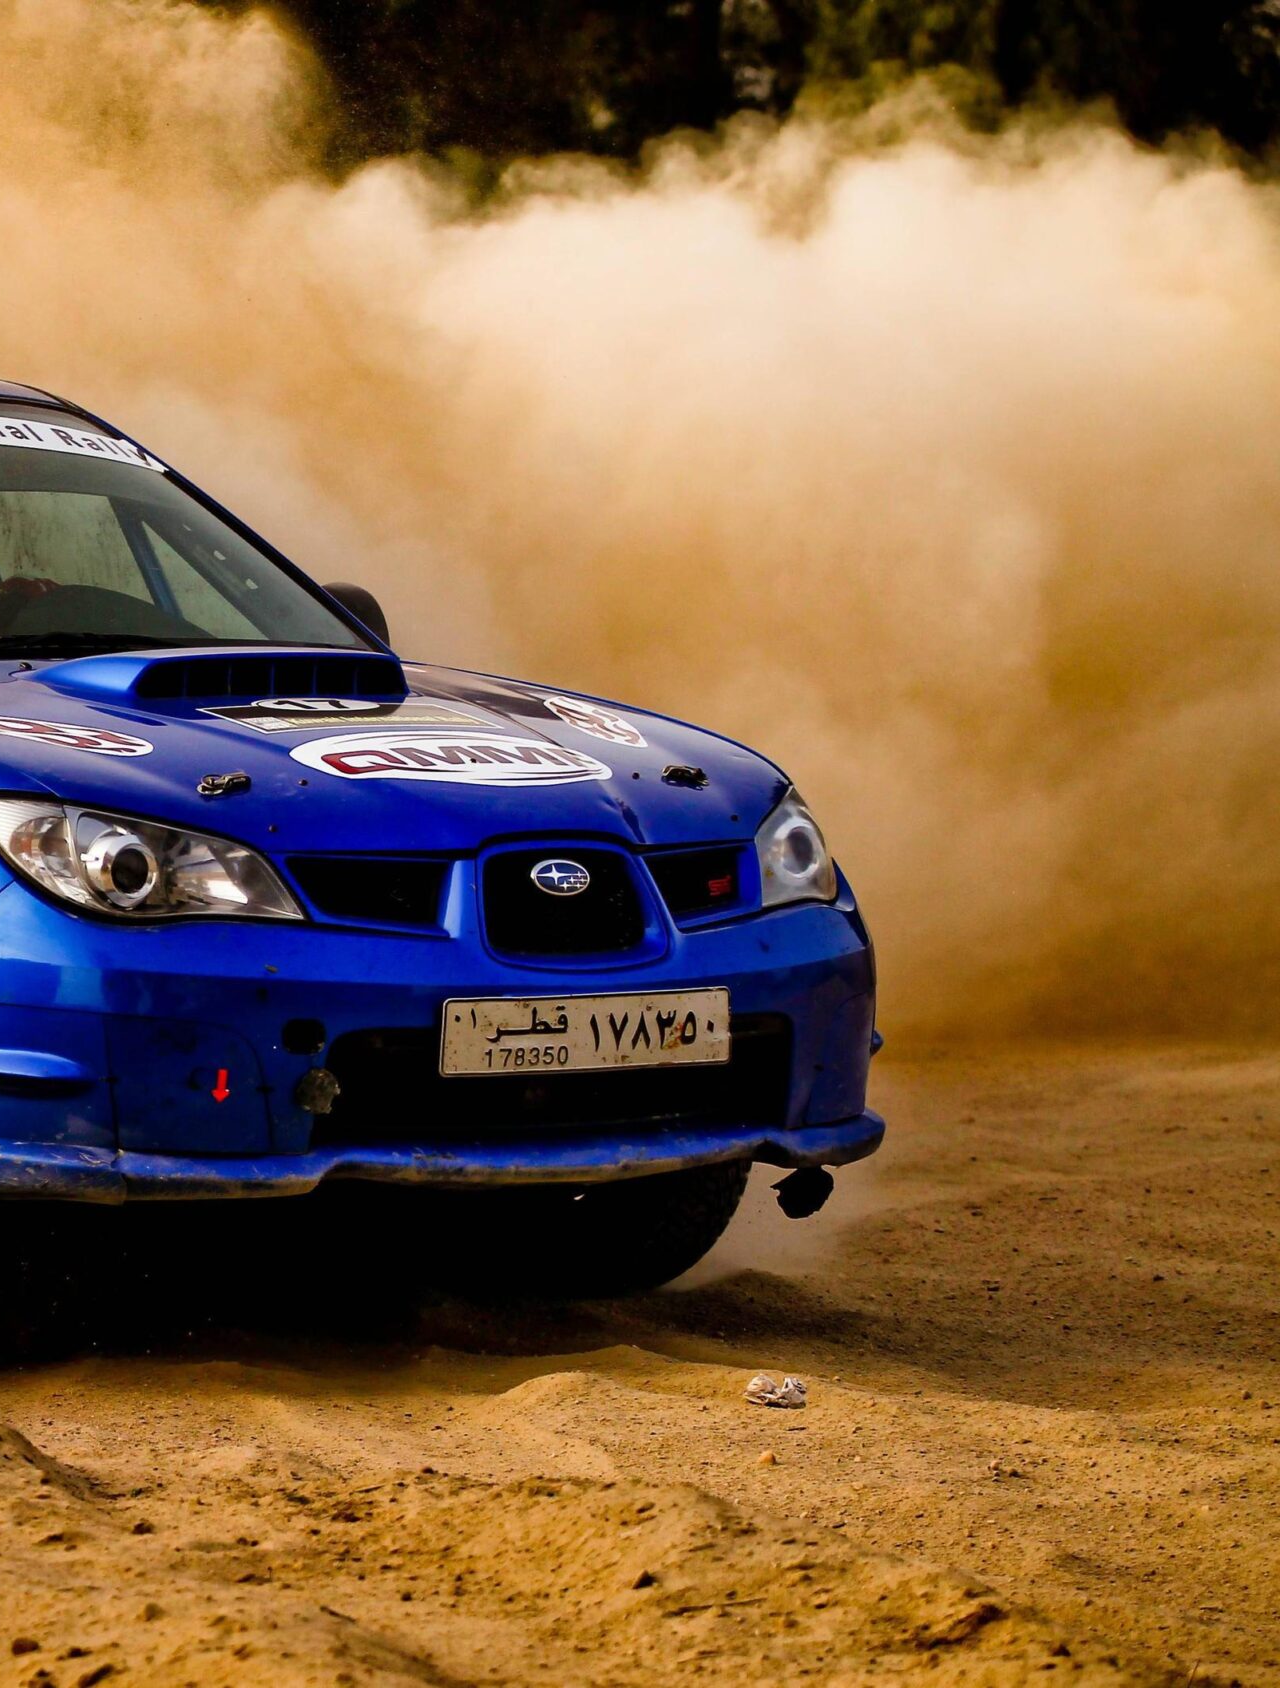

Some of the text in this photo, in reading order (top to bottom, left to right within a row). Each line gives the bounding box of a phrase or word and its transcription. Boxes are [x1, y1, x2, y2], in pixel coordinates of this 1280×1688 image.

[273, 700, 349, 710] 17
[320, 745, 596, 774] QMMF
[486, 1005, 569, 1043] قطر
[589, 1009, 714, 1053] ١٧٨٣٥٠
[485, 1045, 569, 1068] 178350
